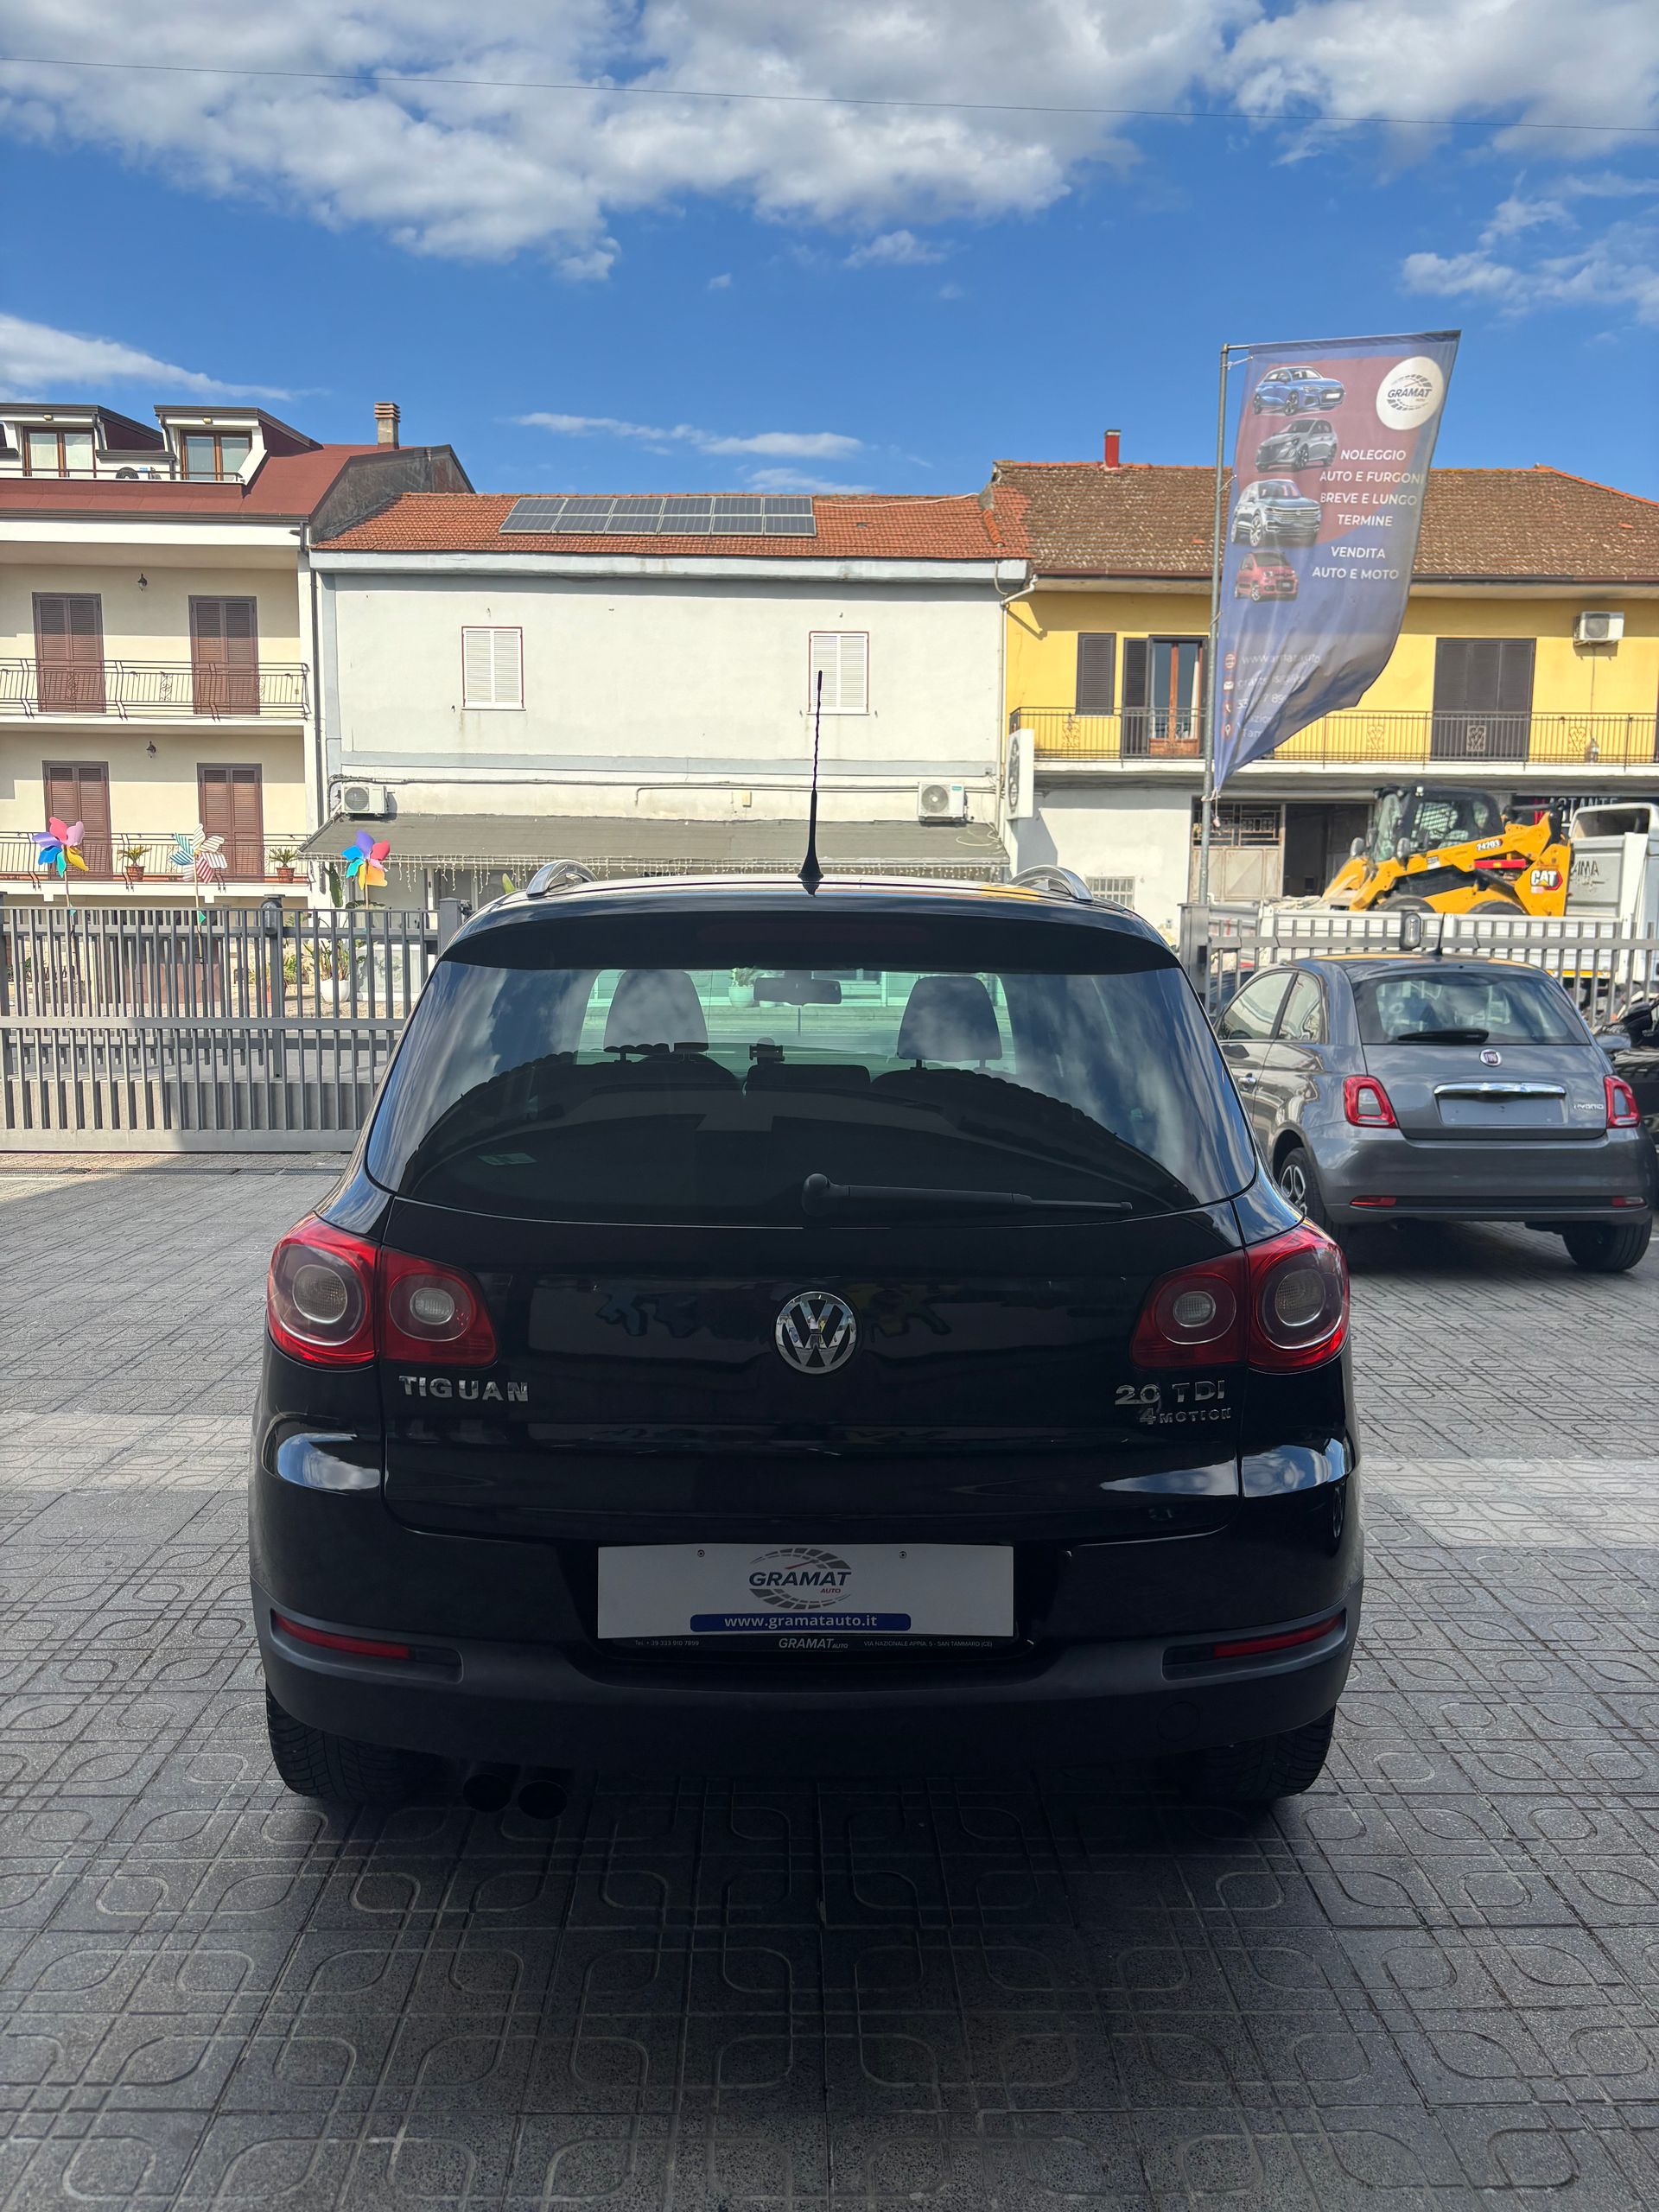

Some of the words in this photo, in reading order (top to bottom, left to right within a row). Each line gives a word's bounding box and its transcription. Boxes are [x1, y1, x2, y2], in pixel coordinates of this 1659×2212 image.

[1388, 388, 1433, 397] GRAMAT
[1340, 449, 1407, 461] NOLEGGIO
[1319, 471, 1352, 482] AUTO
[1356, 471, 1363, 482] E
[1366, 471, 1425, 485] FURGONI
[1320, 492, 1358, 504] BREVE
[1361, 493, 1369, 504] E
[1372, 493, 1417, 505] LUNGO
[1337, 514, 1393, 526] TERMINE
[1331, 546, 1386, 559] VENDITA
[1312, 567, 1346, 579] AUTO
[1350, 569, 1357, 579] E
[1361, 569, 1399, 580] MOTO
[1530, 869, 1557, 886] CAT
[399, 1376, 529, 1402] TIGUAN
[1172, 1380, 1225, 1402] TDI
[749, 1571, 852, 1586] GRAMAT
[724, 1614, 878, 1630] www.gramatauto.it
[779, 1637, 835, 1649] GRAMAT
